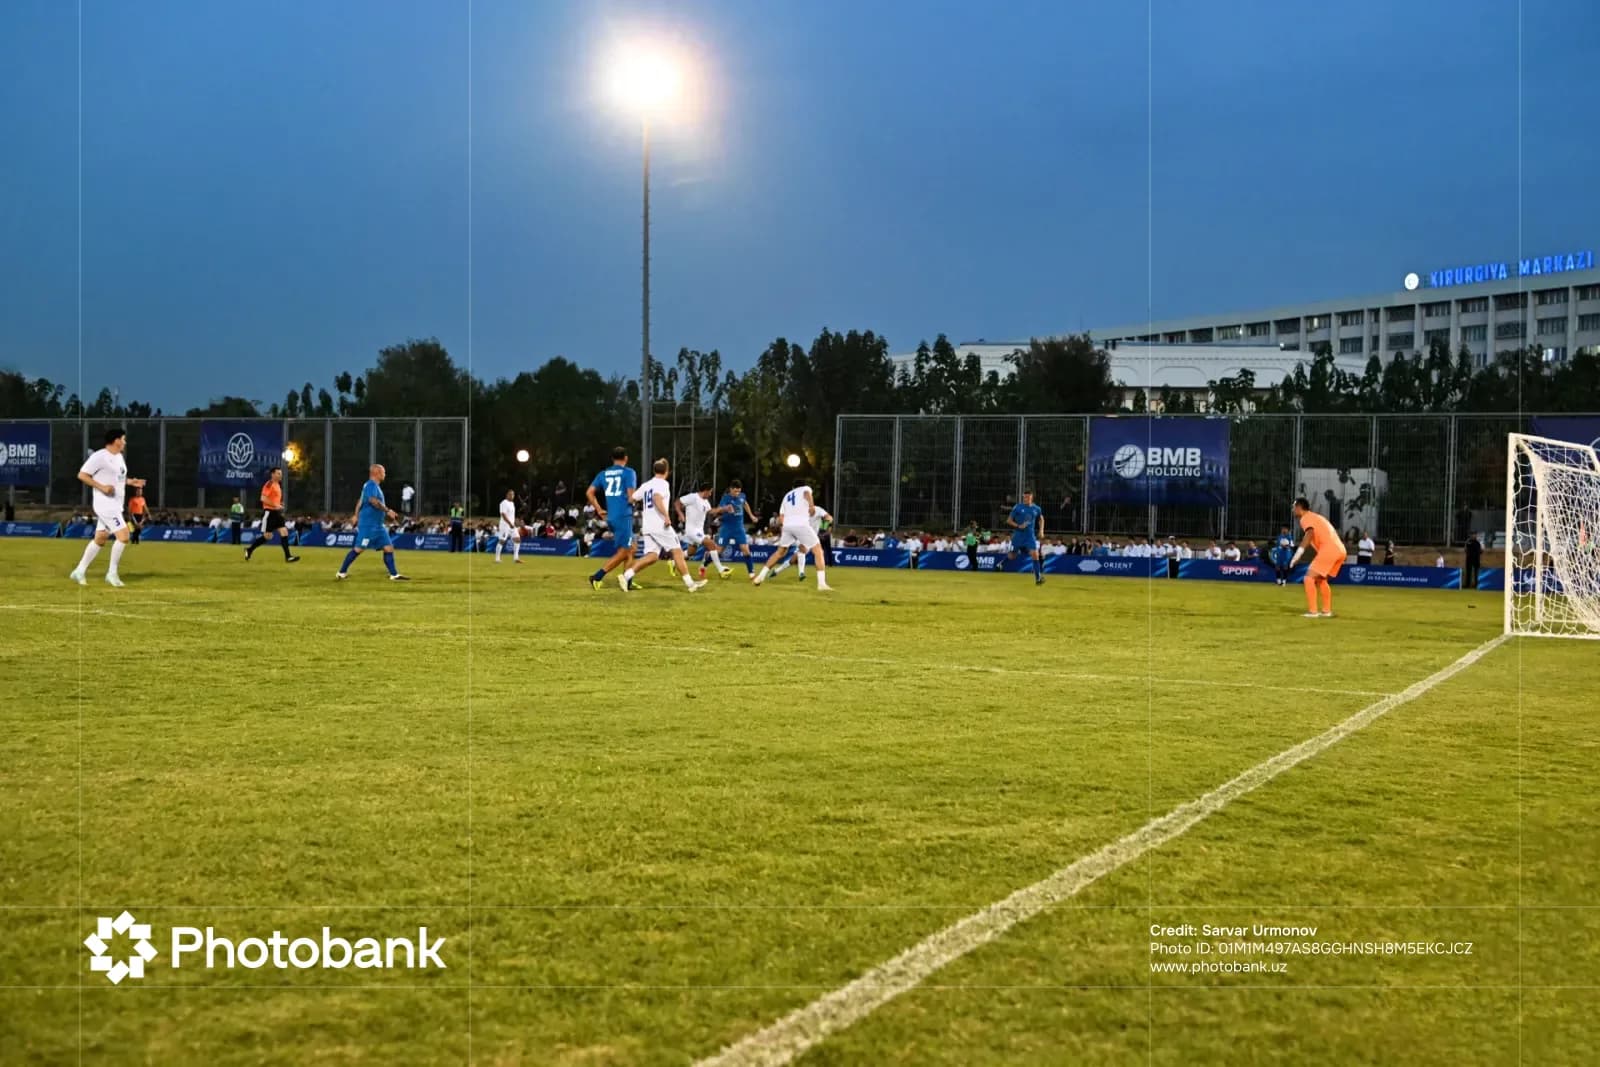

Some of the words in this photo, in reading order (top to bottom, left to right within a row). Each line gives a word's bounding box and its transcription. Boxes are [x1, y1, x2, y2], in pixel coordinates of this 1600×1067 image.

[1430, 262, 1508, 288] KIRURGIYA
[1518, 251, 1593, 276] MARKAZI
[9, 444, 37, 457] BMB
[1147, 447, 1201, 466] BMB
[1146, 467, 1201, 477] HOLDING
[787, 491, 796, 506] 4
[845, 554, 879, 562] SABER
[1103, 561, 1133, 569] ORIENT
[1221, 566, 1256, 576] SPORT
